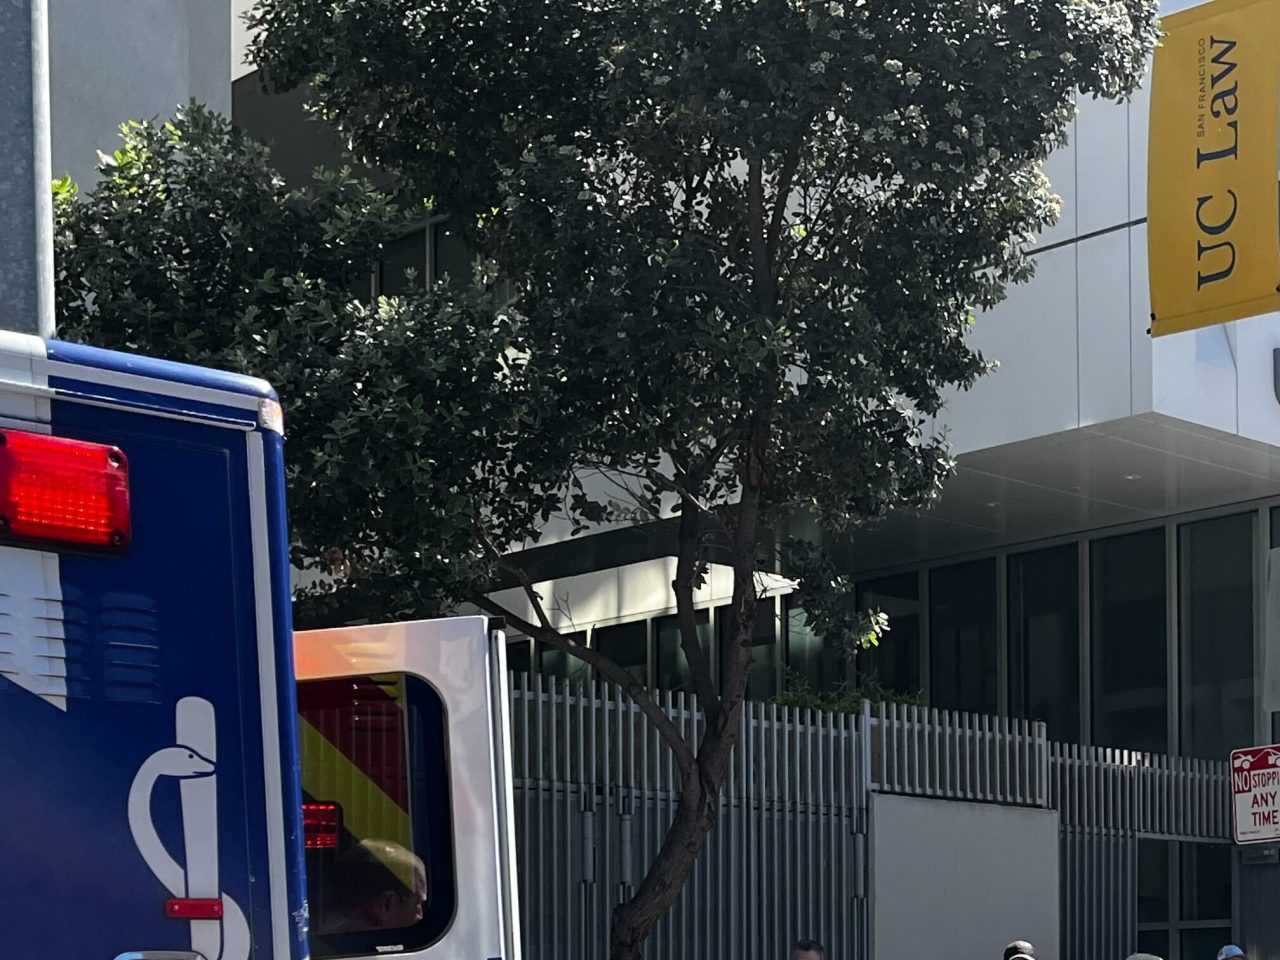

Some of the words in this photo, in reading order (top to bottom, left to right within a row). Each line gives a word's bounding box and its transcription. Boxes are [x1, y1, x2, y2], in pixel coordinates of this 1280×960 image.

[1198, 38, 1206, 109] FRANCISCO
[1196, 35, 1238, 169] Law
[1197, 114, 1206, 138] SAN
[1196, 189, 1238, 292] UC
[1234, 771, 1250, 792] NO
[1251, 791, 1277, 808] ANY
[1251, 809, 1279, 826] TIME
